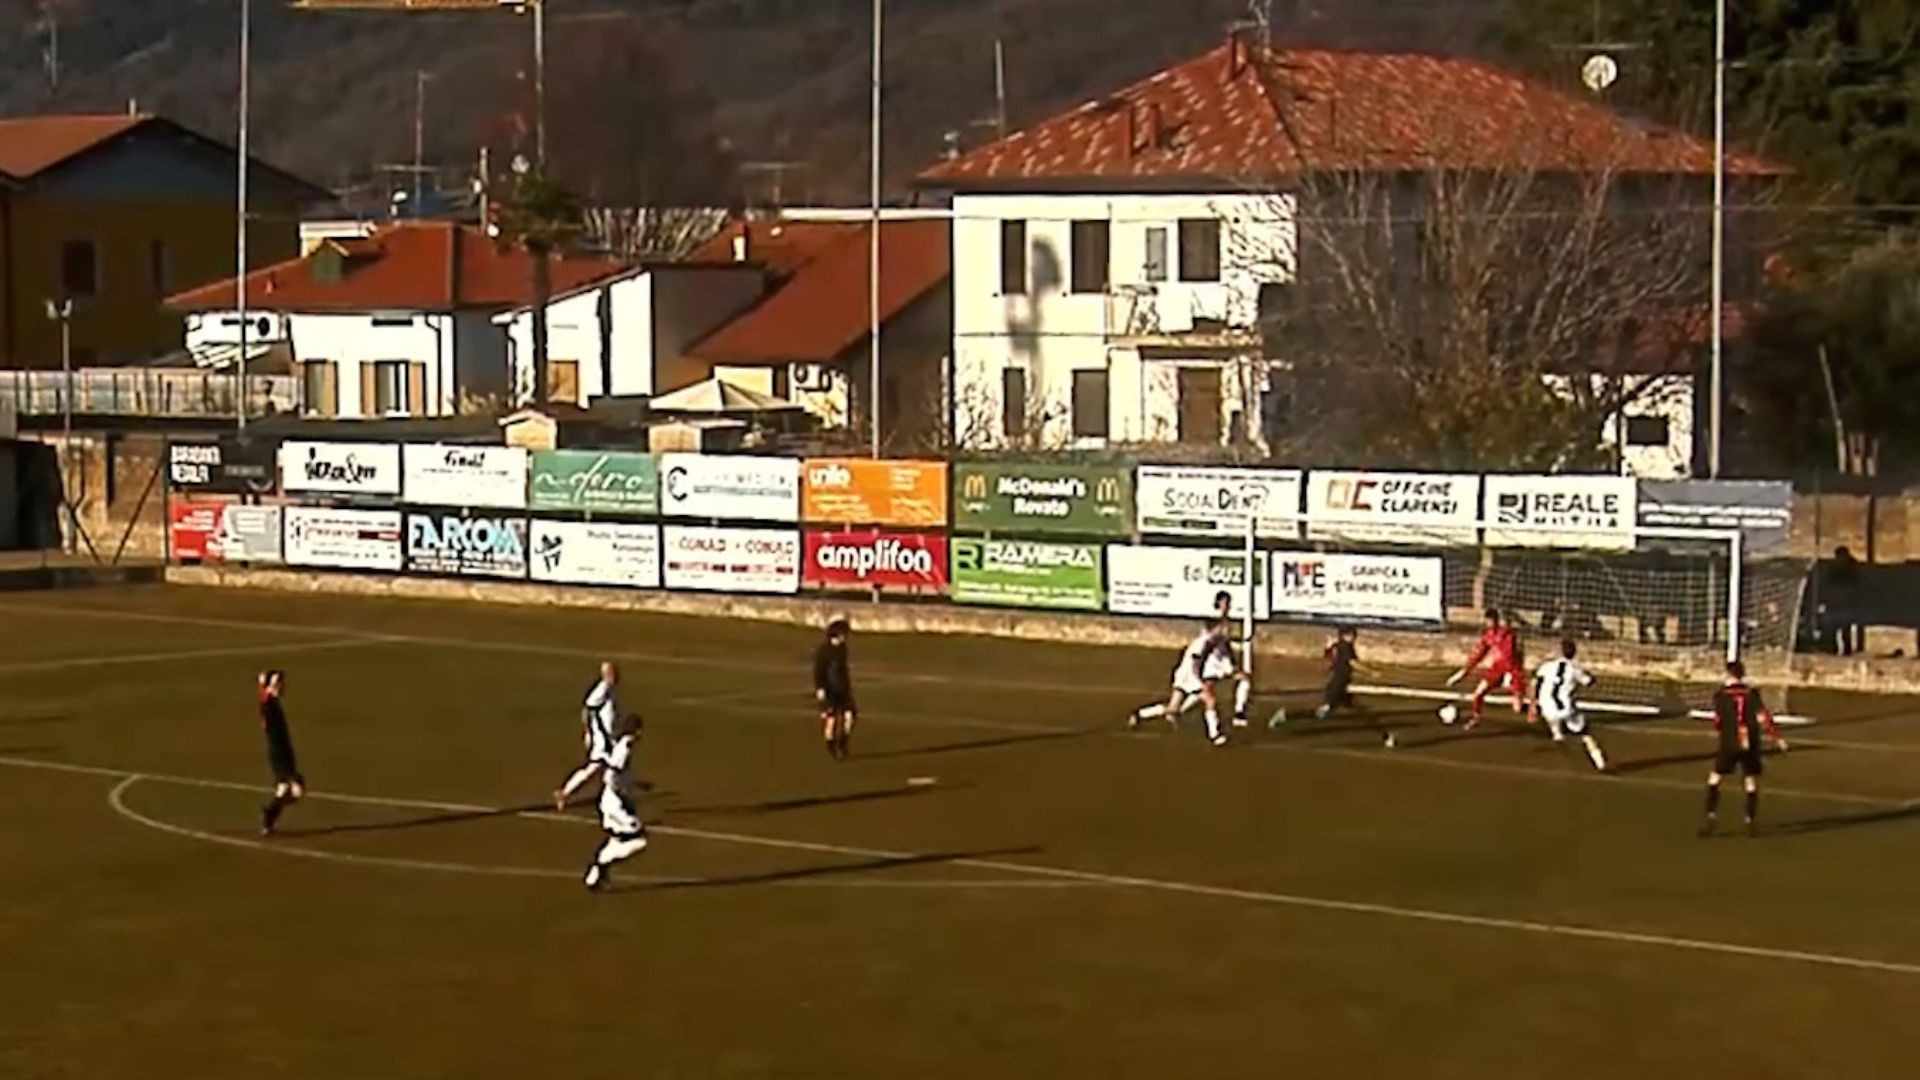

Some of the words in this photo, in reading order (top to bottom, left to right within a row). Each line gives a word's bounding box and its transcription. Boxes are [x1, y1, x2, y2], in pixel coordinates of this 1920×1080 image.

[997, 477, 1087, 497] McDonald's
[1382, 480, 1453, 497] OFFICINE
[1535, 493, 1619, 513] REALE
[679, 536, 726, 552] CONAD
[744, 538, 794, 554] CONAD
[817, 539, 932, 578] amplifon
[985, 543, 1095, 568] RAMERA
